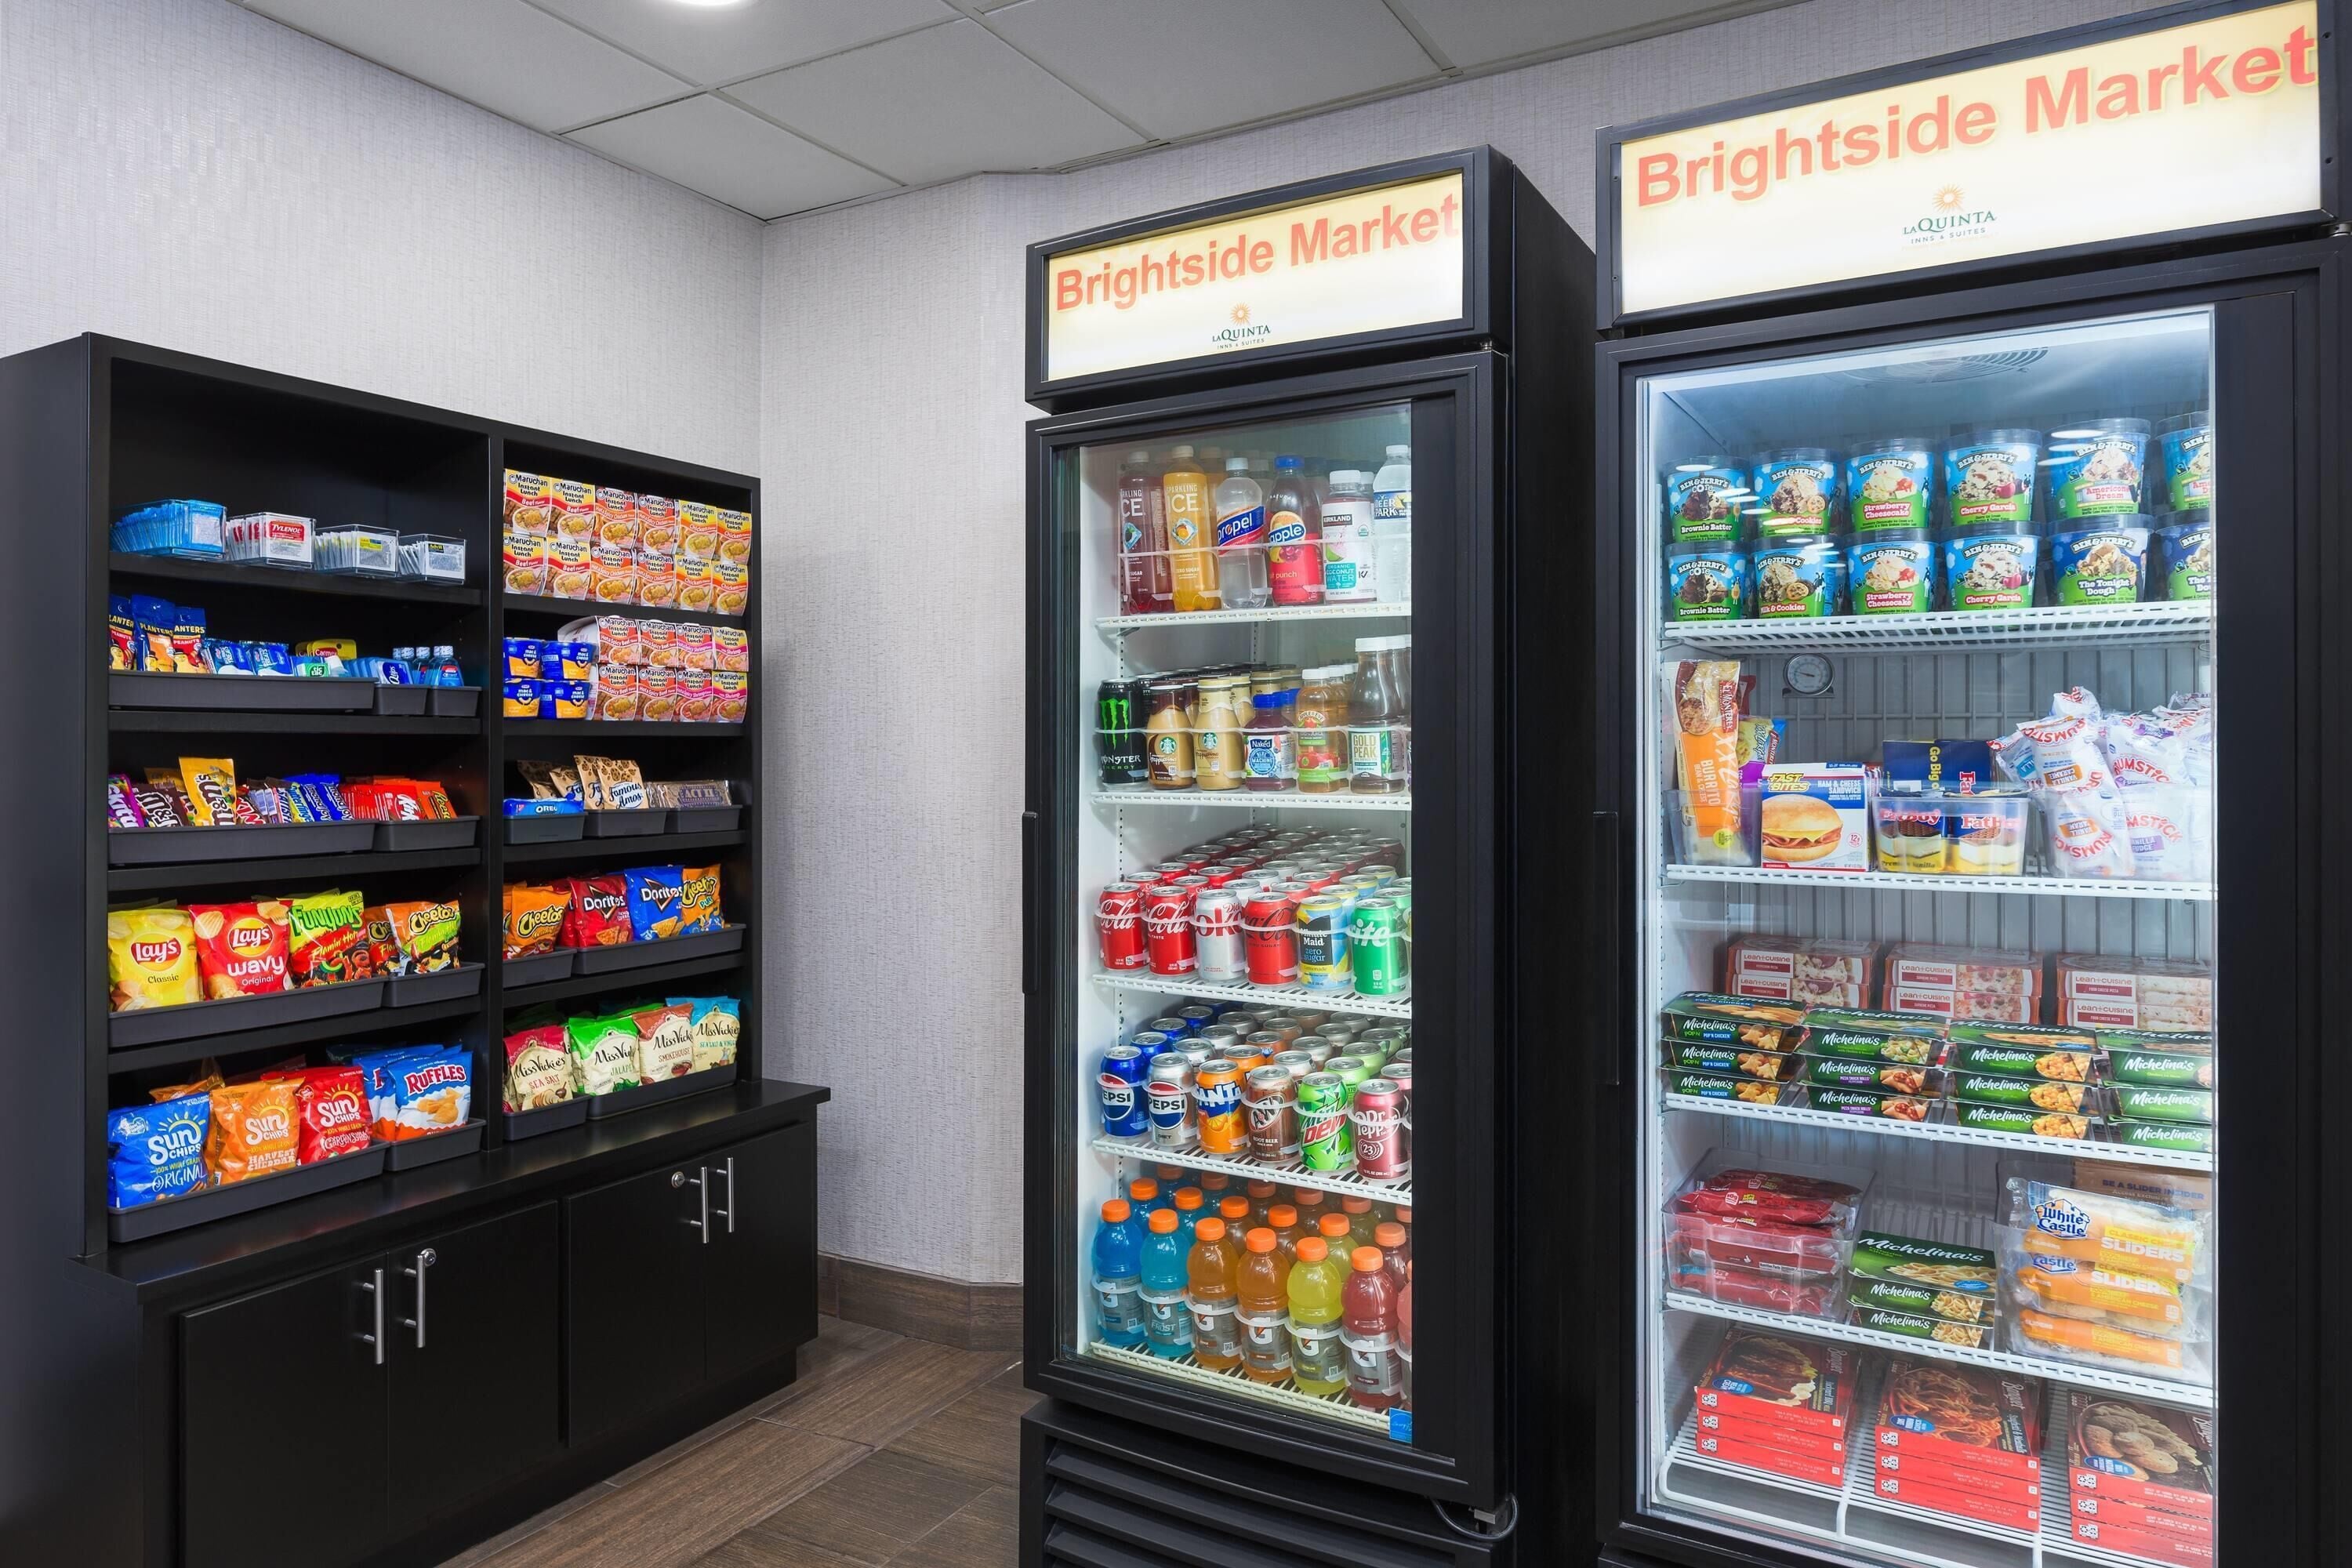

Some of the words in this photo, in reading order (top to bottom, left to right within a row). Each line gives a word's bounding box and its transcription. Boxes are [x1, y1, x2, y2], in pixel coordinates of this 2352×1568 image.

[1638, 96, 1997, 207] Brightside
[2025, 25, 2316, 134] Market
[1918, 211, 1994, 232] QUINTA
[1911, 235, 1935, 244] INNS
[1949, 227, 1985, 238] SUITES
[1057, 234, 1273, 310] Brightside
[1290, 193, 1458, 268] Market
[1221, 325, 1270, 341] QUINTA
[516, 475, 547, 486] Maruchan
[561, 483, 591, 494] Maruchan
[563, 491, 584, 499] Instant
[687, 505, 714, 514] Maruchan
[1864, 503, 1911, 513] Strawberry
[1865, 510, 1910, 519] Cheesecake
[1960, 505, 1988, 514] Cherry
[272, 524, 302, 534] TYLENOL
[1218, 514, 1253, 543] propel
[1681, 524, 1709, 534] Brownie
[557, 543, 587, 552] Maruchan
[2096, 579, 2130, 589] Tonight
[1866, 593, 1912, 602] Strawberry
[2086, 587, 2115, 596] Dough
[1867, 599, 1912, 608] Cheesecake
[1965, 594, 1995, 604] Cherry
[1353, 735, 1375, 745] GOLD
[1354, 747, 1376, 757] PEAK
[1929, 746, 1940, 762] Go
[1929, 763, 1941, 781] Big
[1700, 759, 1721, 805] BURRITO
[641, 887, 683, 901] Doritos
[584, 895, 626, 910] Doritos
[519, 906, 563, 936] Cheetos
[233, 925, 271, 948] Lay's
[1304, 938, 1325, 946] Maid
[135, 940, 179, 963] Lay's
[227, 956, 284, 976] wavy
[148, 975, 180, 983] Classic
[242, 976, 274, 985] Original
[1683, 1018, 1737, 1032] Michelina's
[1822, 1033, 1880, 1046] Michelina's
[1682, 1046, 1735, 1060] Michelina's
[1971, 1049, 2035, 1062] Michelina's
[514, 1062, 536, 1079] Miss
[1818, 1061, 1876, 1075] Michelina's
[2125, 1058, 2194, 1072] Michelina's
[405, 1065, 466, 1094] RUFFLES
[528, 1078, 544, 1090] SEA
[546, 1074, 560, 1084] SALT
[1681, 1076, 1733, 1089] Michelina's
[1965, 1077, 2029, 1091] Michelina's
[1149, 1098, 1185, 1110] PEPSI
[1819, 1091, 1877, 1105] Michelina's
[2131, 1091, 2200, 1106] Michelina's
[318, 1098, 358, 1127] Sun
[335, 1112, 361, 1123] CHIPS
[1969, 1109, 2032, 1123] Michelina's
[246, 1115, 288, 1145] Sun
[263, 1128, 289, 1141] CHIPS
[148, 1129, 201, 1164] Sun
[169, 1145, 201, 1158] CHIPS
[1363, 1145, 1374, 1154] 23
[249, 1148, 295, 1163] HARVEST
[249, 1157, 295, 1171] CHEDDAR
[2102, 1179, 2116, 1188] BE
[2127, 1182, 2161, 1194] SLIDER
[2164, 1189, 2205, 1200] INSIDER
[2042, 1206, 2083, 1225] White
[2038, 1219, 2085, 1236] Castle
[2101, 1238, 2184, 1263] SLIDERS
